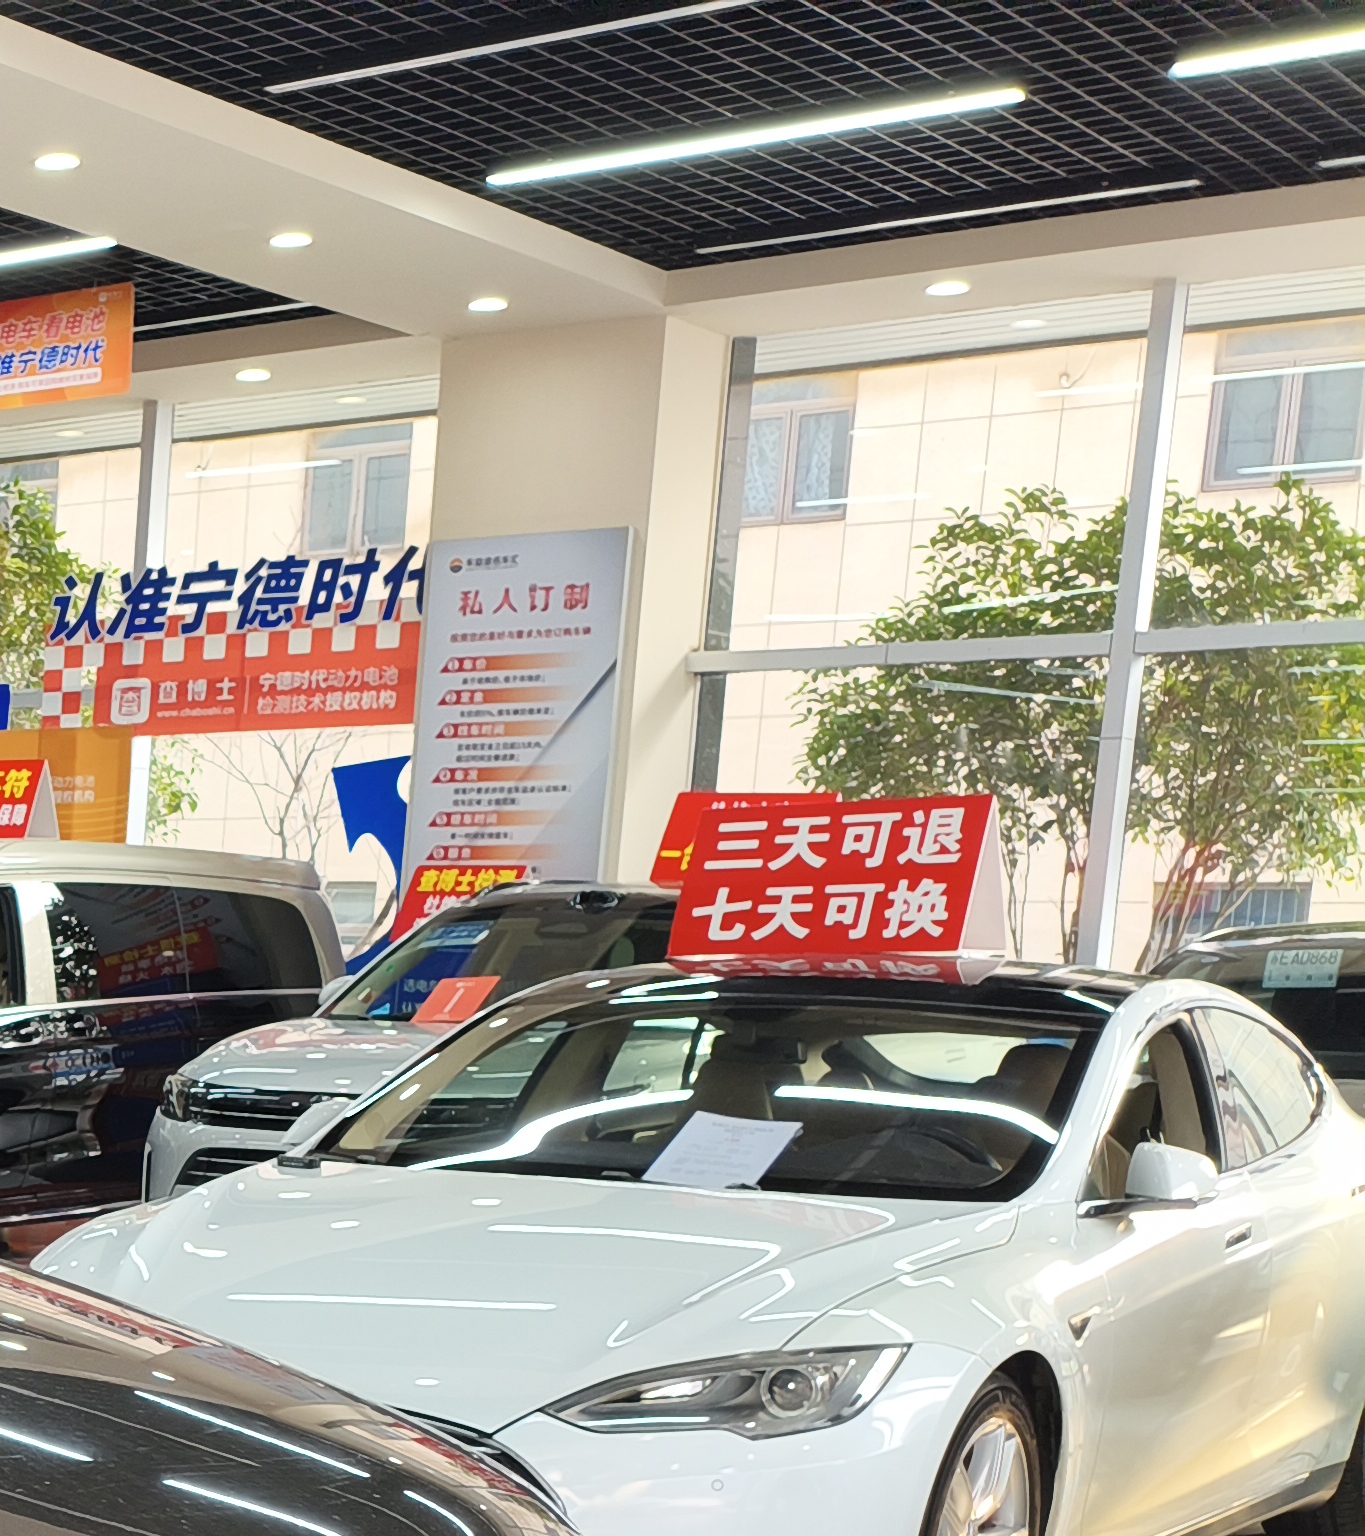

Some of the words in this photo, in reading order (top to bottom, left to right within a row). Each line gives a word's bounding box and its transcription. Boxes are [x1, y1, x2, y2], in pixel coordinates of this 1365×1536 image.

[458, 582, 590, 617] 私人订制
[156, 678, 237, 704] 查博士
[258, 666, 399, 693] 宁德时代动力电池
[257, 690, 397, 714] 检测技术授权机构
[704, 807, 965, 871] 三天可退
[692, 878, 949, 941] 七天可换
